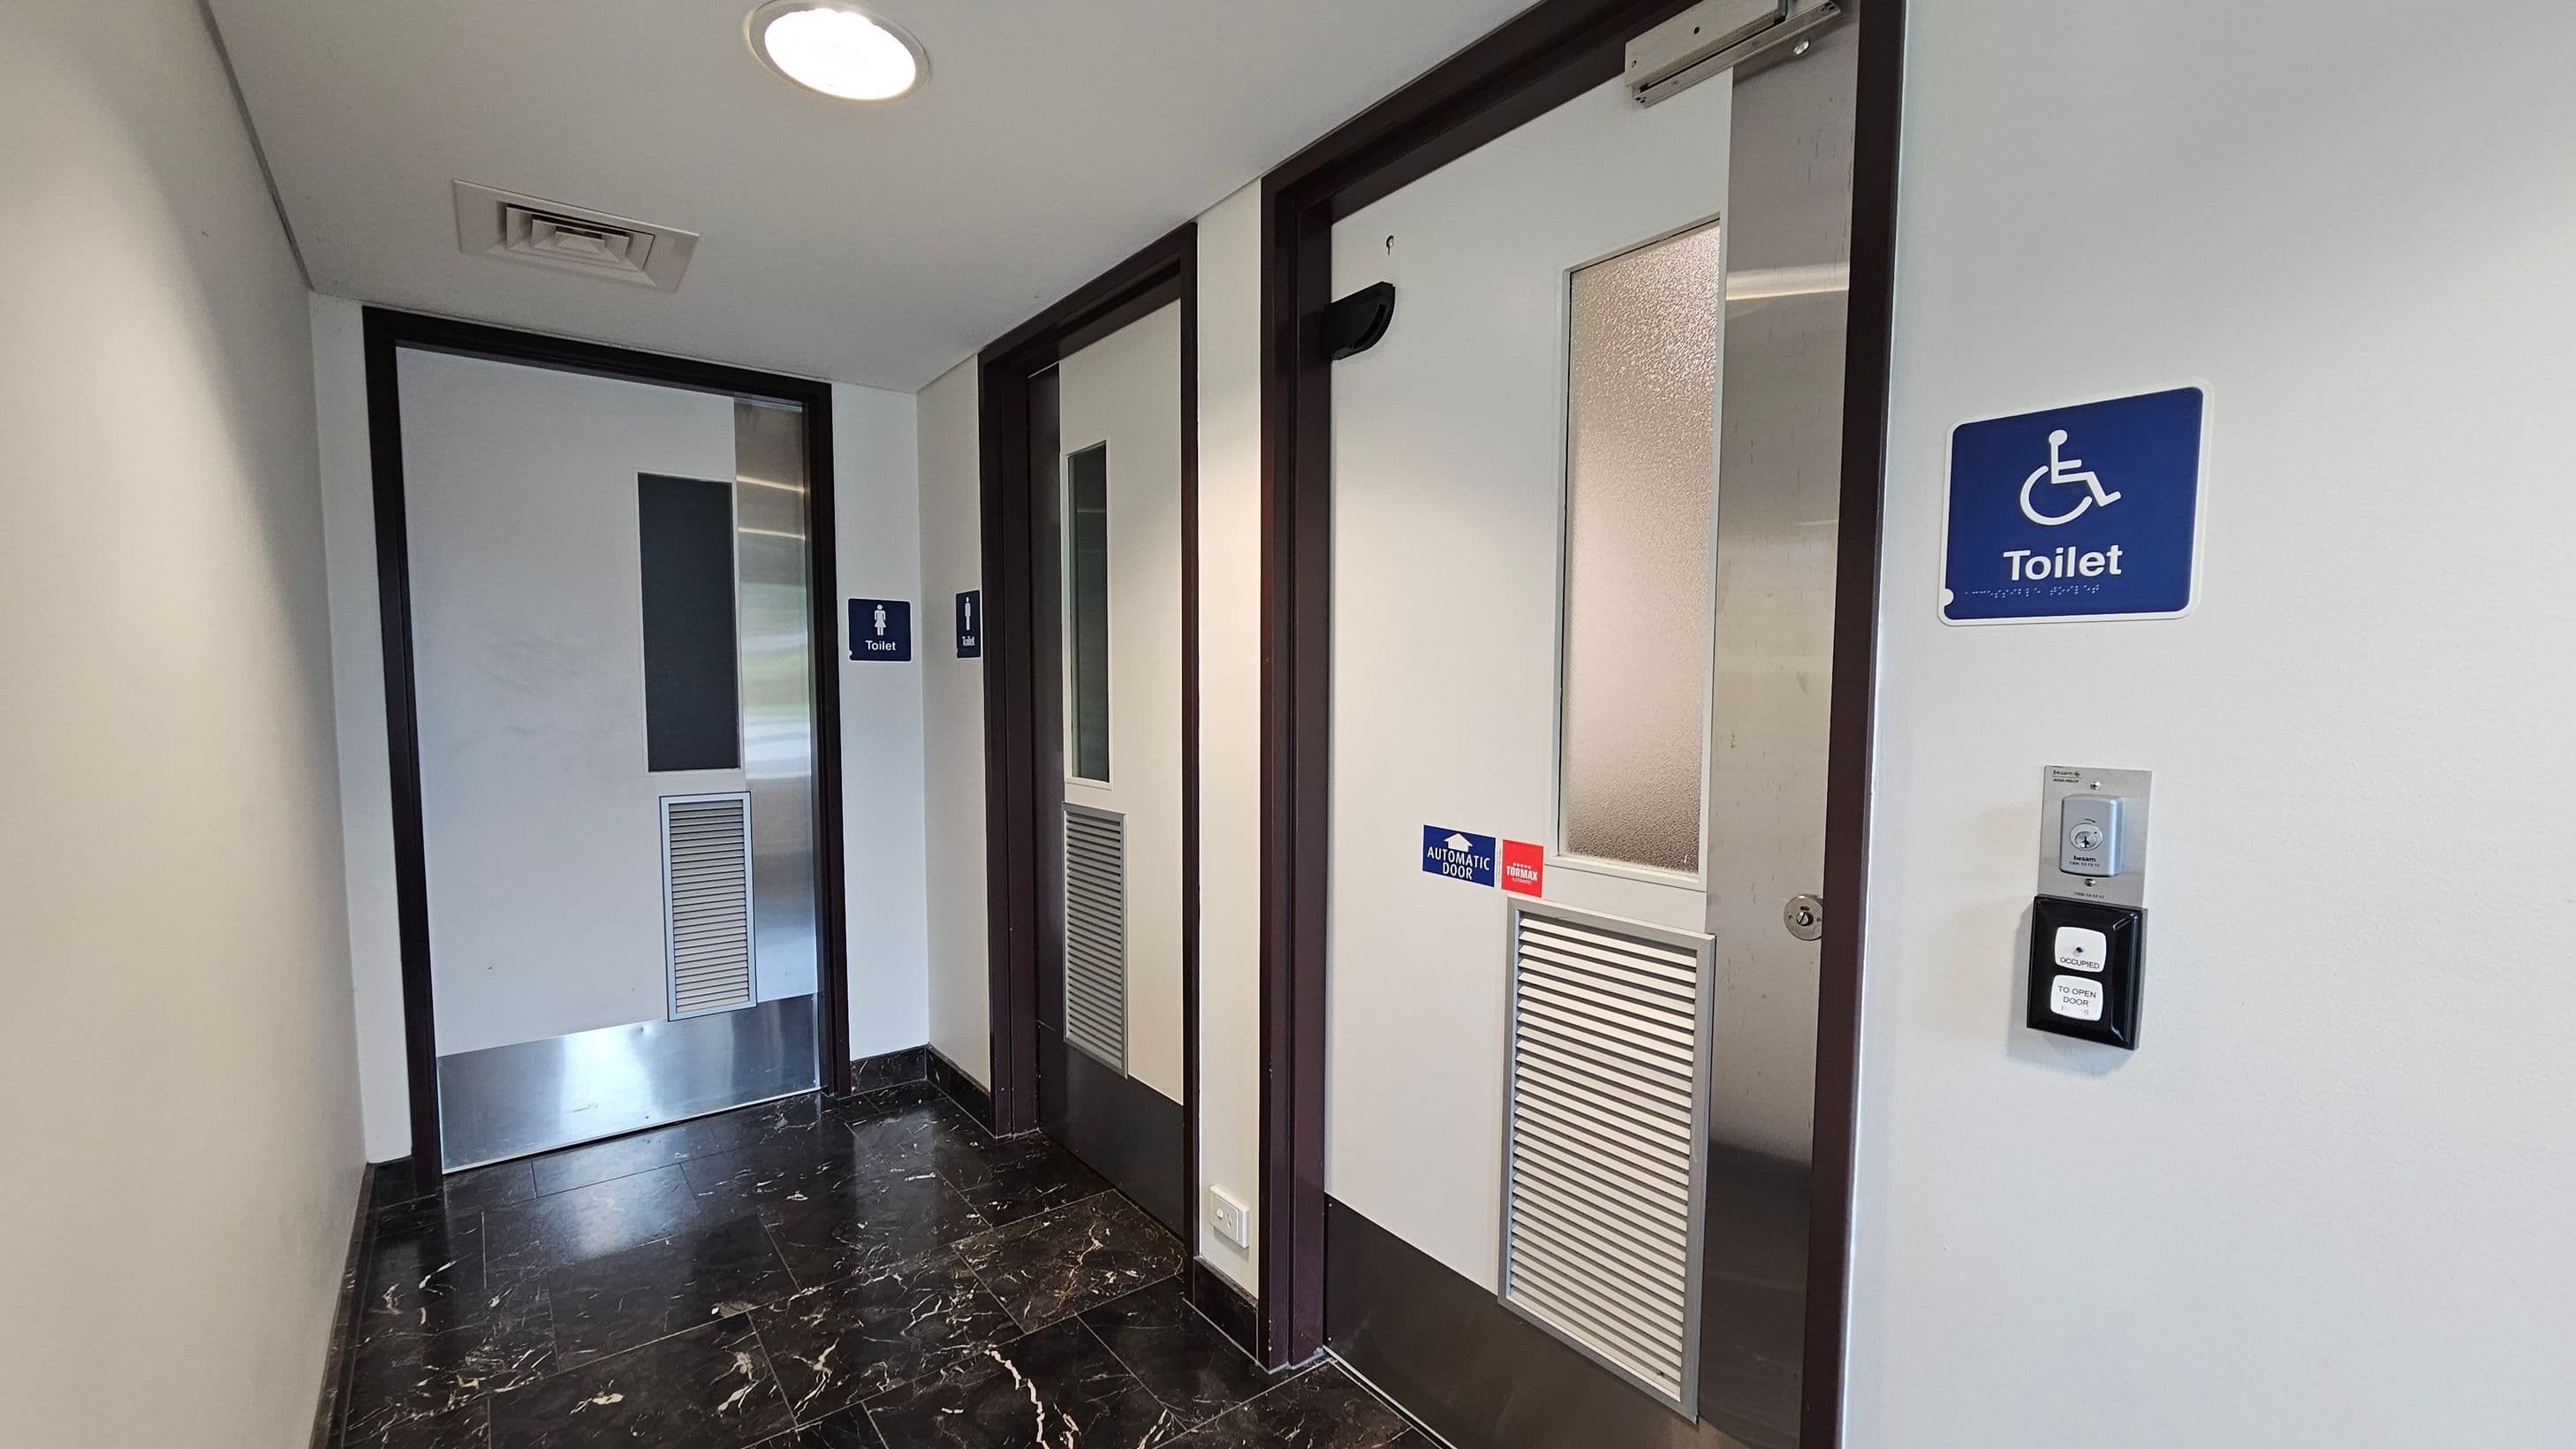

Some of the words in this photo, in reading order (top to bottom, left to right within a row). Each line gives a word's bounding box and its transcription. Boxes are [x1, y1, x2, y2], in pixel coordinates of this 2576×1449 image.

[2003, 544, 2123, 580] Toilet
[865, 640, 897, 651] Toilet
[1428, 846, 1490, 870] AUTOMATIC
[1442, 862, 1473, 880] DOOR
[1506, 865, 1538, 882] TORMAX
[2060, 957, 2099, 968] OCCUPIED
[2072, 988, 2096, 998] OPEN
[2064, 996, 2089, 1007] DOOR
